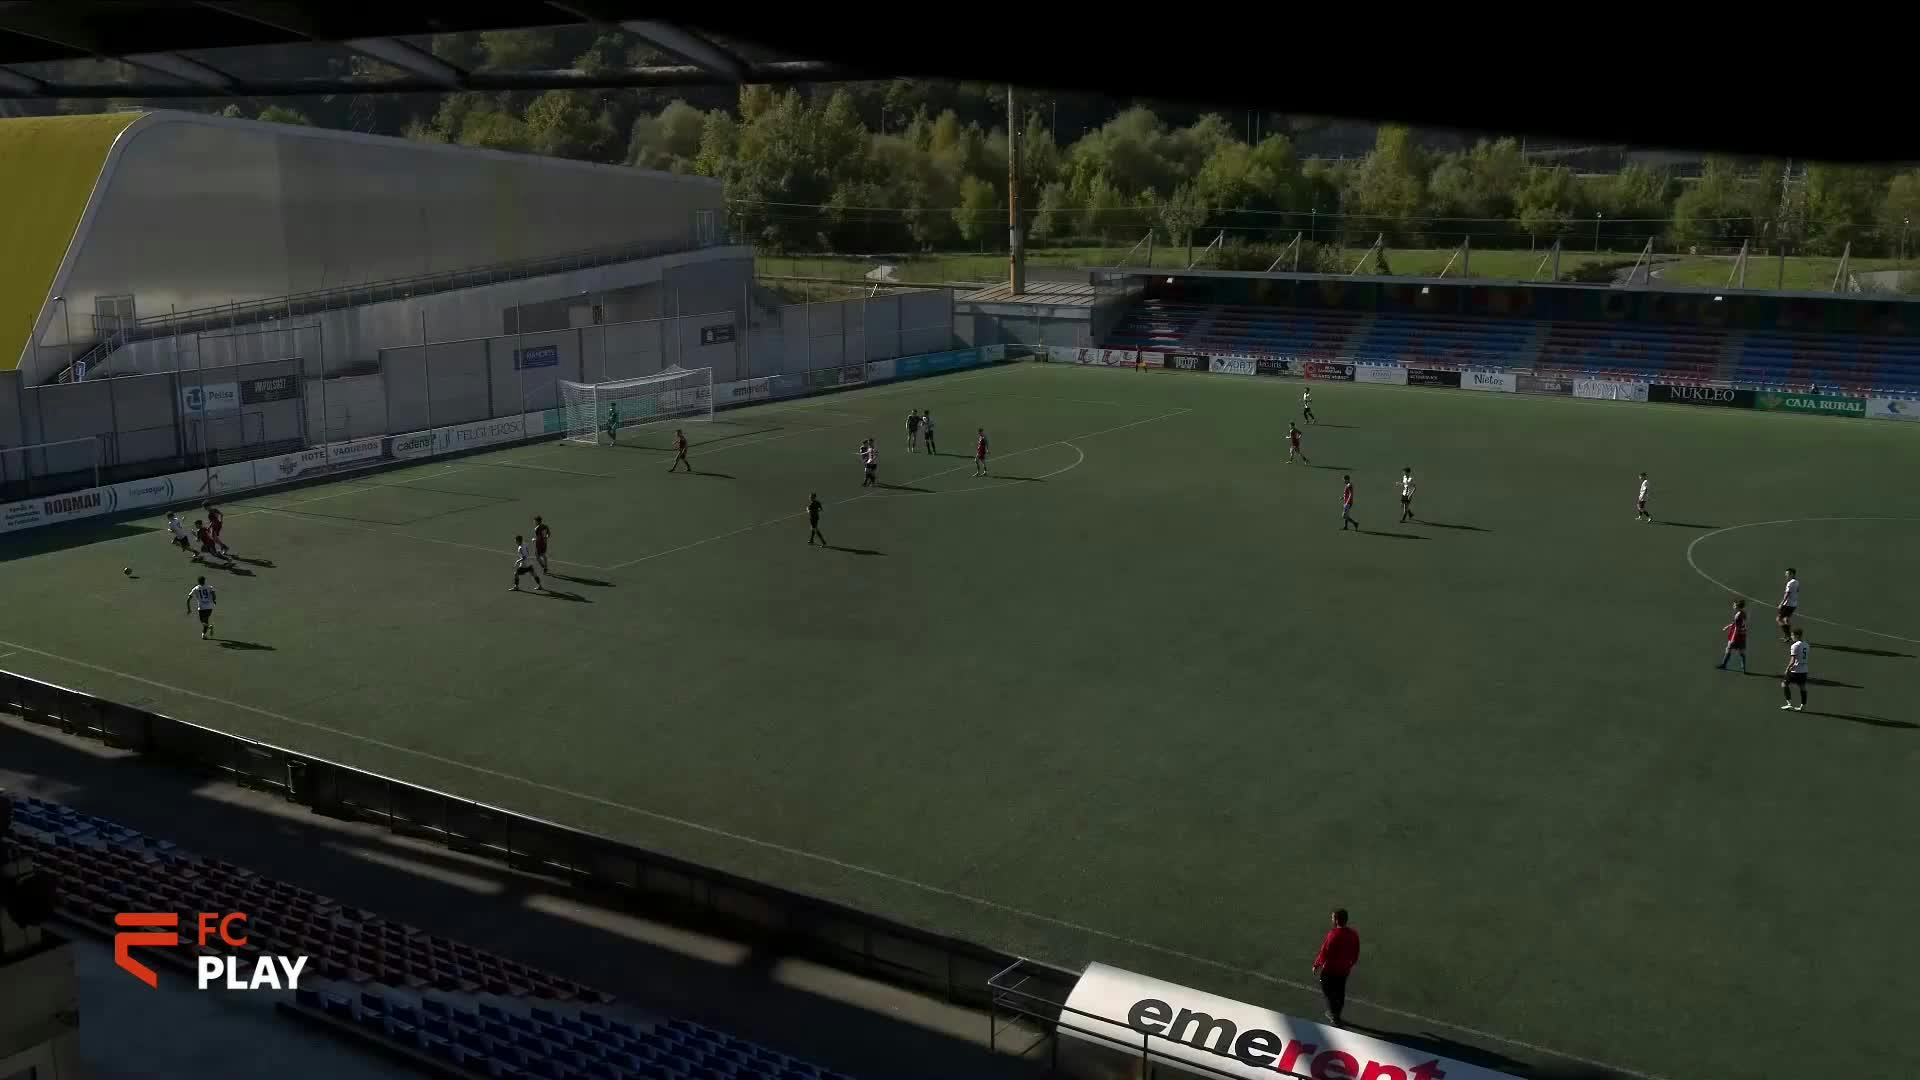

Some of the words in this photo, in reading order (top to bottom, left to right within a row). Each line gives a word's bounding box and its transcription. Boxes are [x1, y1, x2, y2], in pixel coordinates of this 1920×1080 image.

[1670, 386, 1735, 402] NUKLEO
[1785, 398, 1816, 409] CAJA
[1819, 400, 1864, 412] RURAL
[301, 449, 328, 462] HOTE
